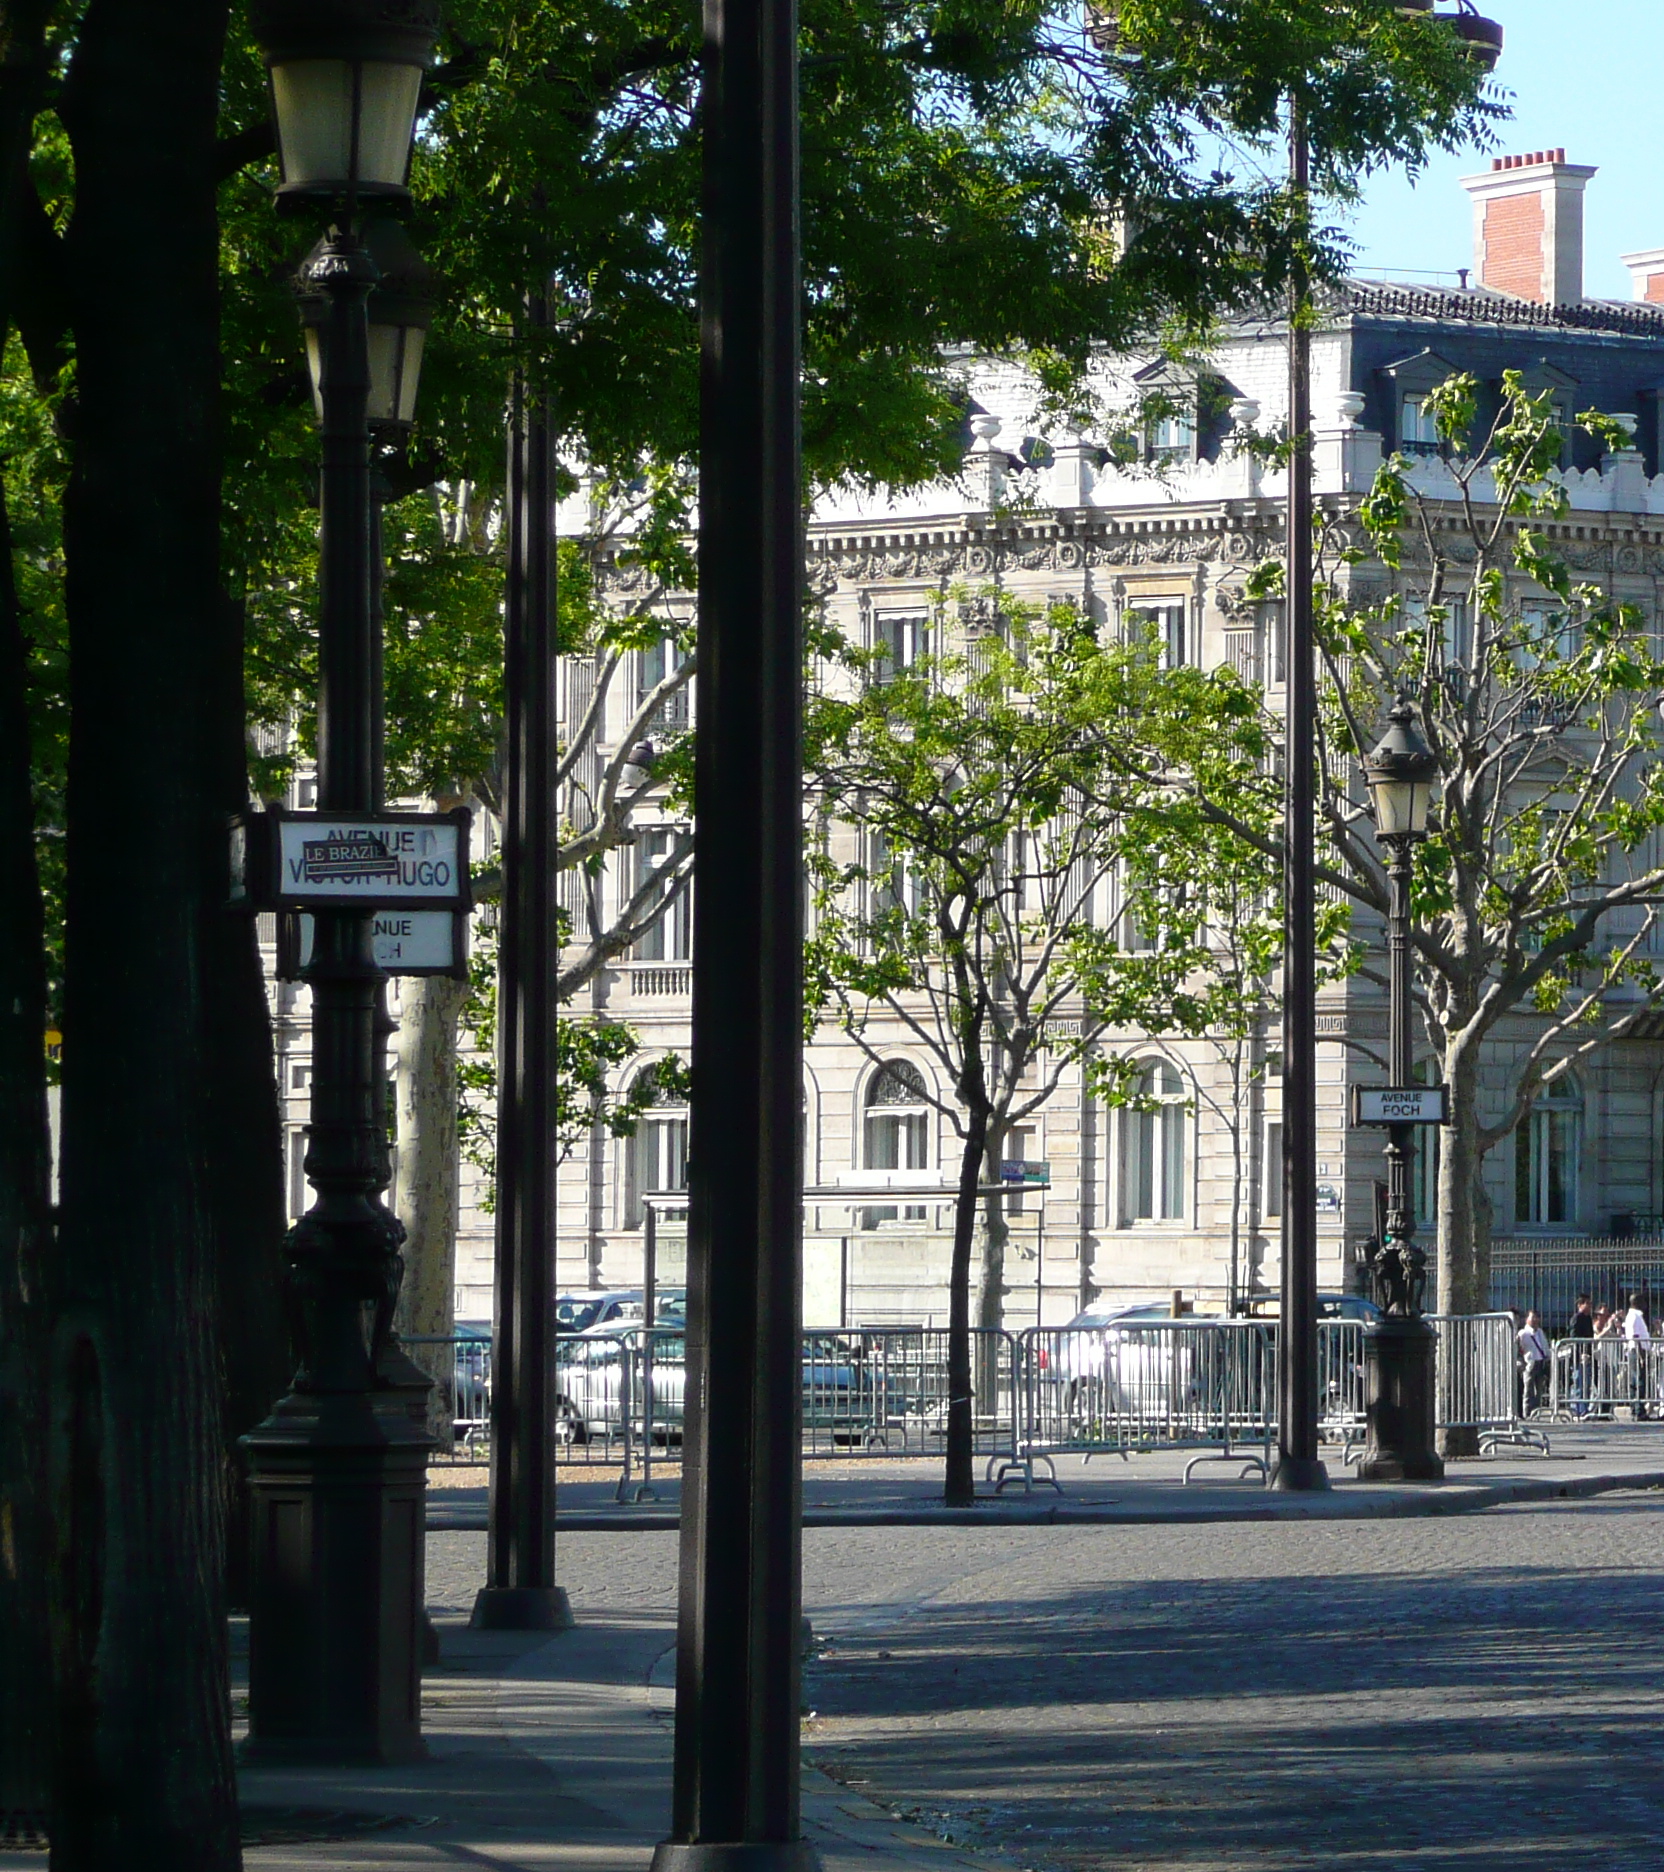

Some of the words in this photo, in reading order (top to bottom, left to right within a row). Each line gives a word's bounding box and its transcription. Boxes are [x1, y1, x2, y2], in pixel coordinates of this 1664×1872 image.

[306, 848, 325, 861] LE
[1381, 1093, 1422, 1102] AVENUE
[1383, 1105, 1420, 1116] FOCH
